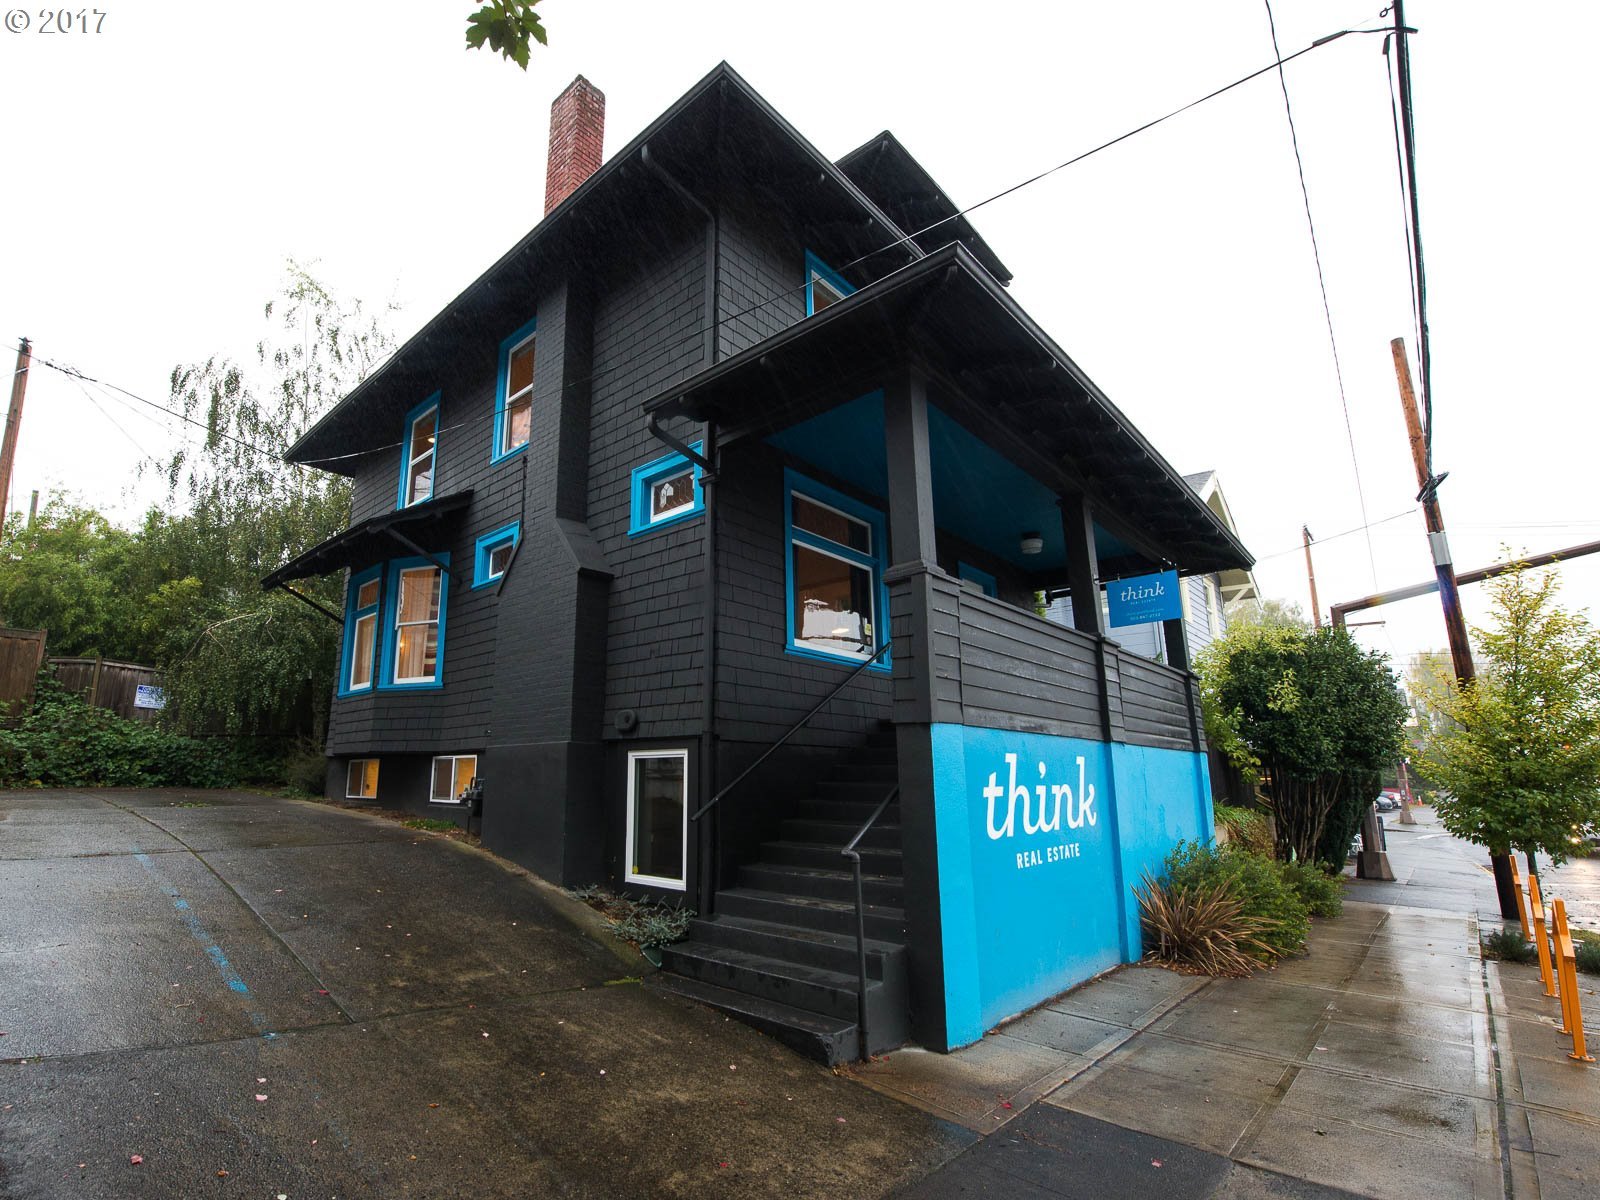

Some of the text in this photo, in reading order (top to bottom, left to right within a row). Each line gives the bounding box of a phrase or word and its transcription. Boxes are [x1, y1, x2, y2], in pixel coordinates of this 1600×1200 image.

[1121, 581, 1165, 602] think
[983, 752, 1097, 840] think
[1016, 842, 1081, 869] REAL ESTATE
